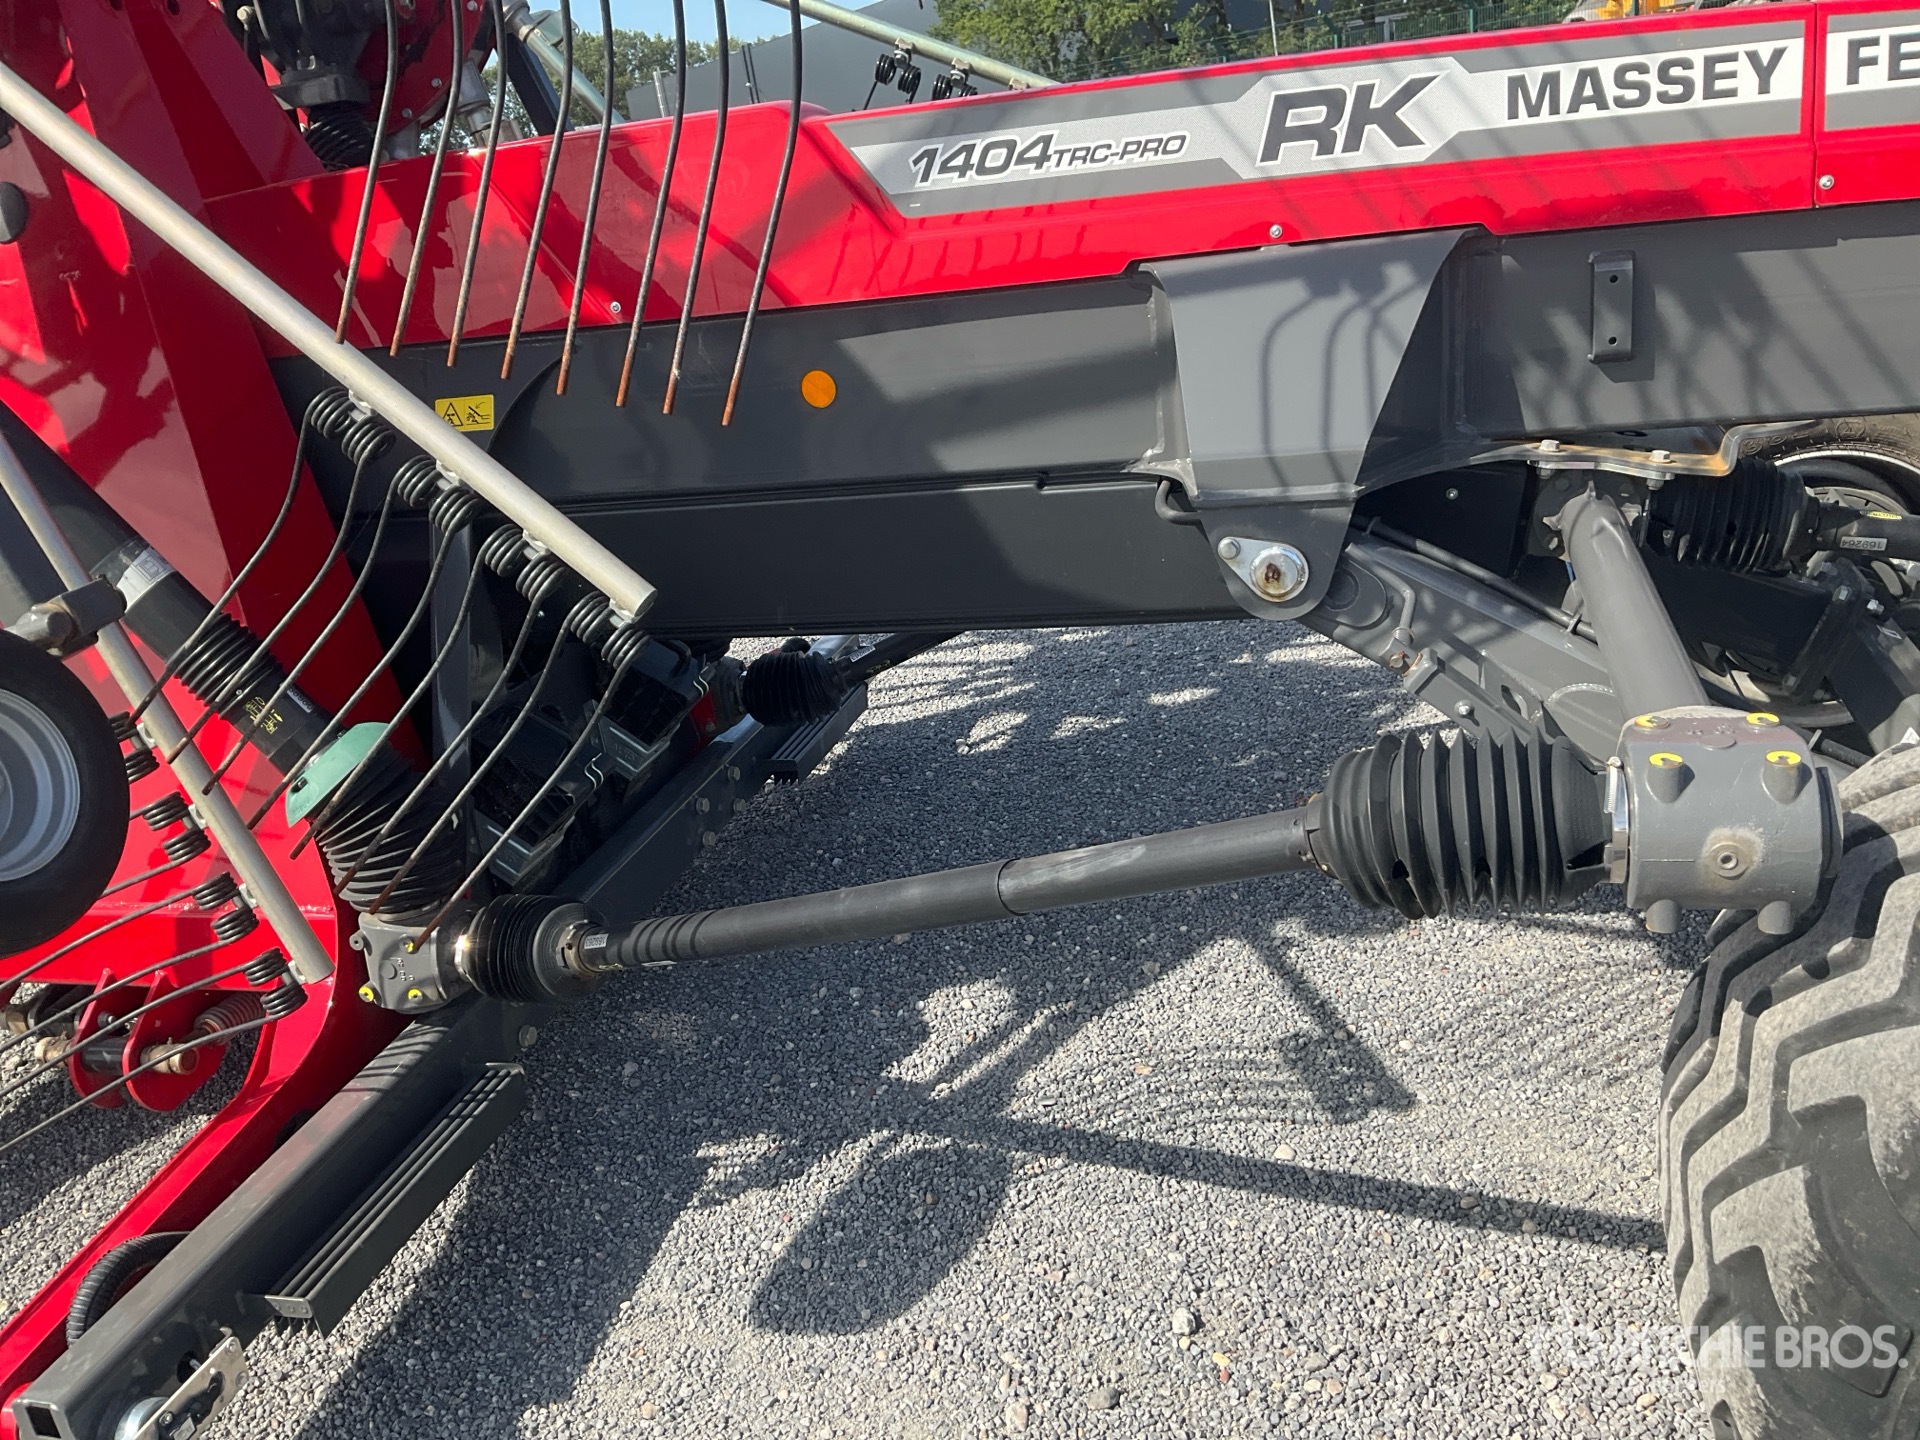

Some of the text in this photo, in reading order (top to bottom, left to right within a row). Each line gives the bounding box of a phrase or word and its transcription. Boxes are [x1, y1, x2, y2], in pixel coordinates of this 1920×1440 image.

[1258, 73, 1443, 165] RK
[1506, 35, 1920, 120] MASSEY FE
[1842, 539, 1884, 550] 169264
